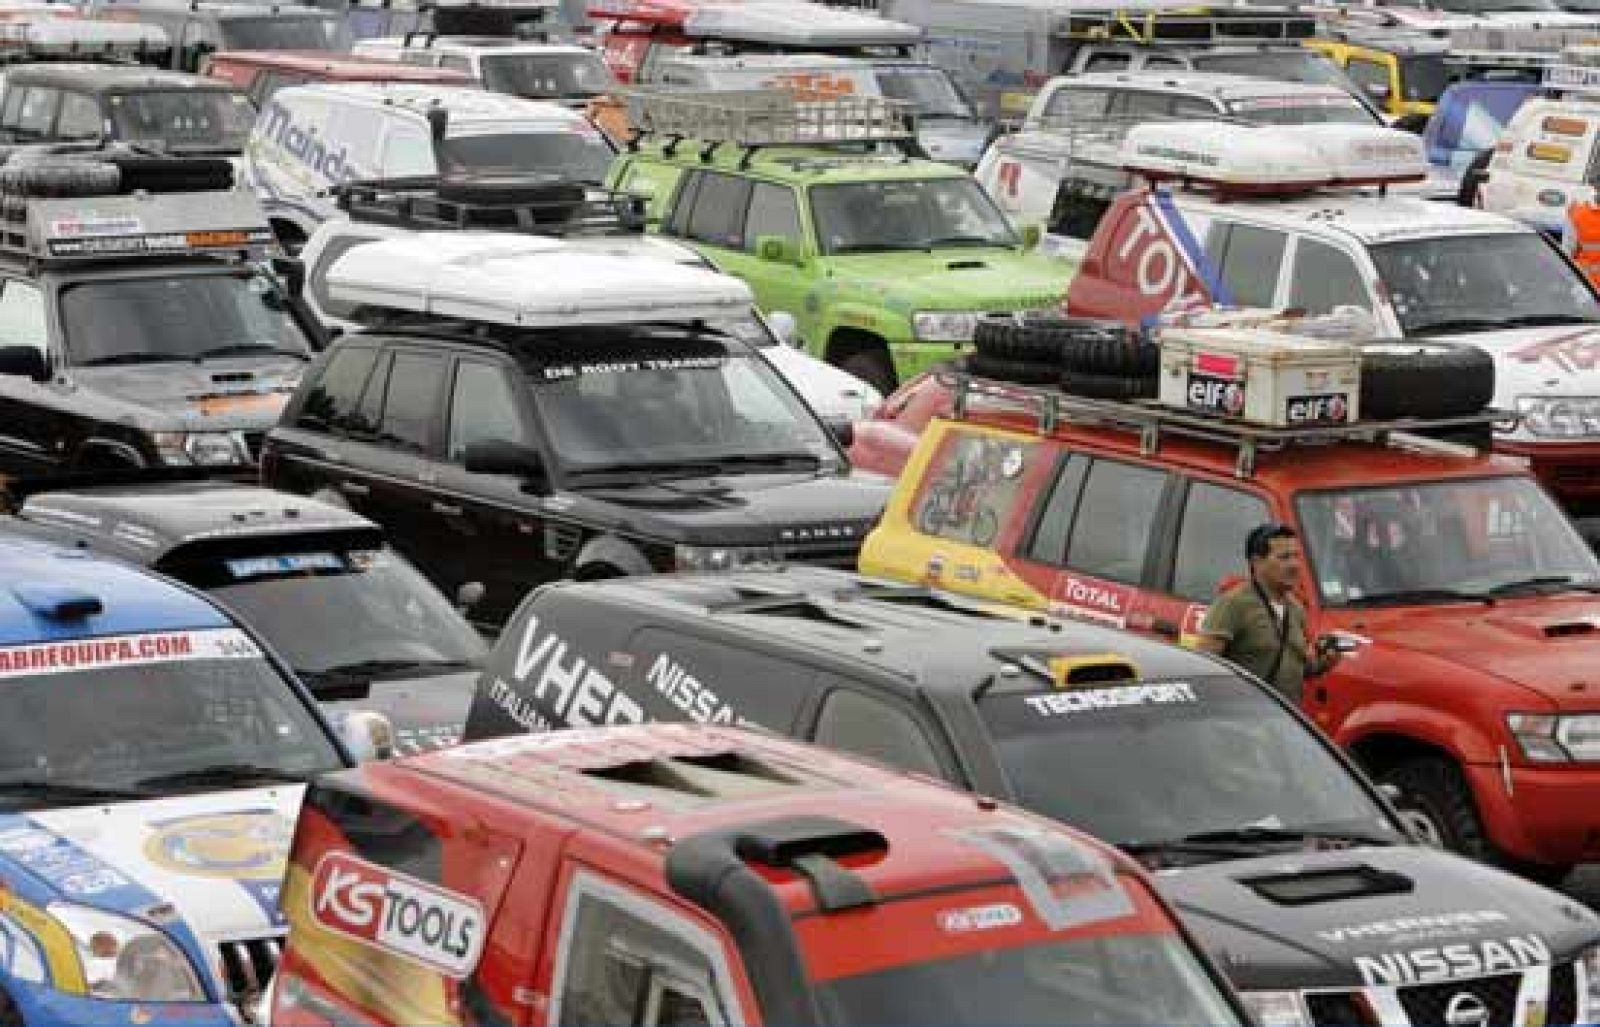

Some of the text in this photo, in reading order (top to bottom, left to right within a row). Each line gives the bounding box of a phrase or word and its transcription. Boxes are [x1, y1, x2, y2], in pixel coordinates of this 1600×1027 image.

[318, 866, 474, 957] KS TOOLS
[1352, 934, 1549, 986] NISSAN
